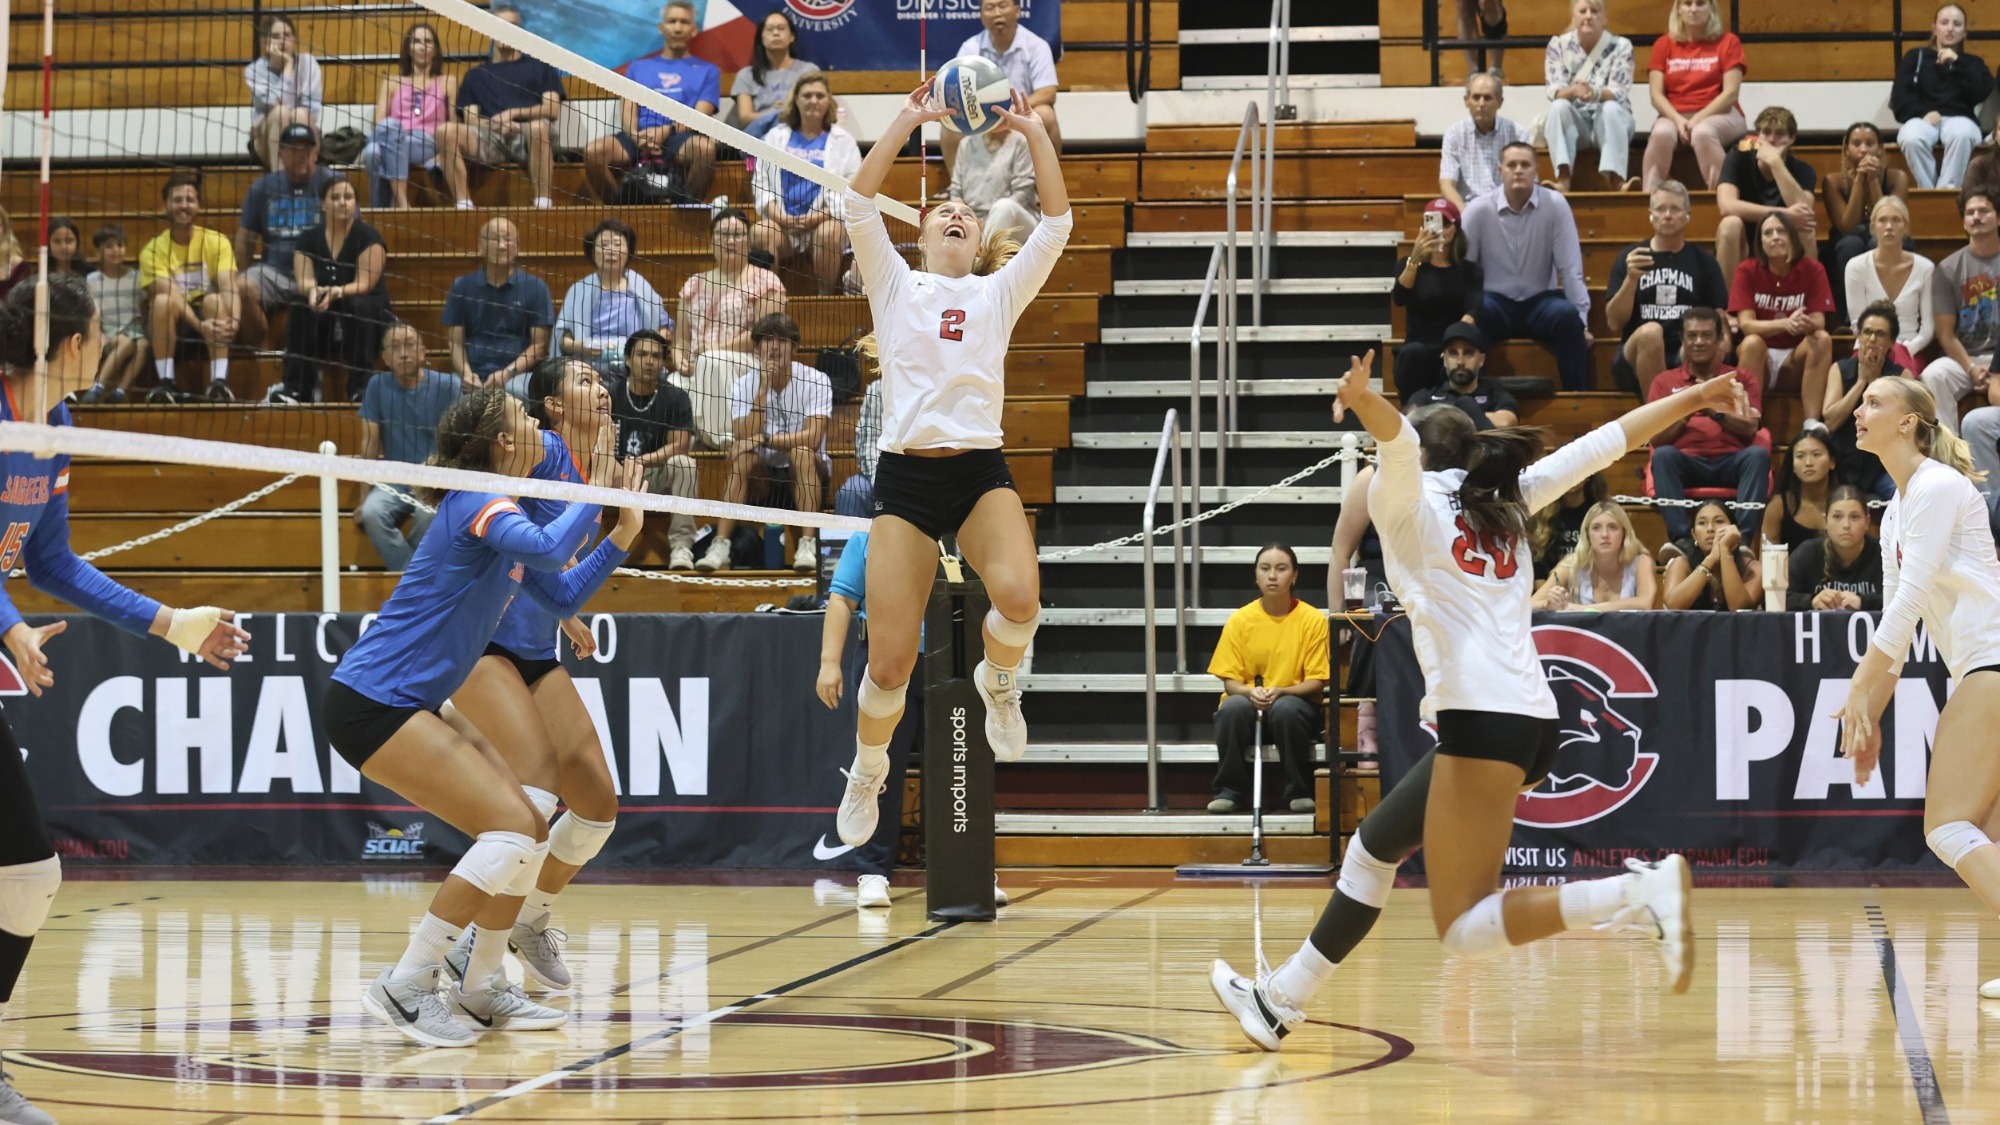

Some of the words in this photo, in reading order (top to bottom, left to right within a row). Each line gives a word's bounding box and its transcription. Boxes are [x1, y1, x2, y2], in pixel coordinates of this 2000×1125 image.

[897, 12, 939, 20] DISCOVER
[961, 76, 979, 120] molten
[1640, 268, 1693, 292] CHAPMAN
[1640, 304, 1692, 320] NIVERSIT
[1754, 292, 1806, 311] VOLLEYBAL
[940, 309, 965, 342] 2
[0, 522, 30, 572] 15
[950, 707, 968, 762] sports
[950, 765, 968, 833] imports
[364, 839, 425, 854] SCIAC
[1504, 847, 1540, 867] VISIT
[1545, 848, 1567, 868] US
